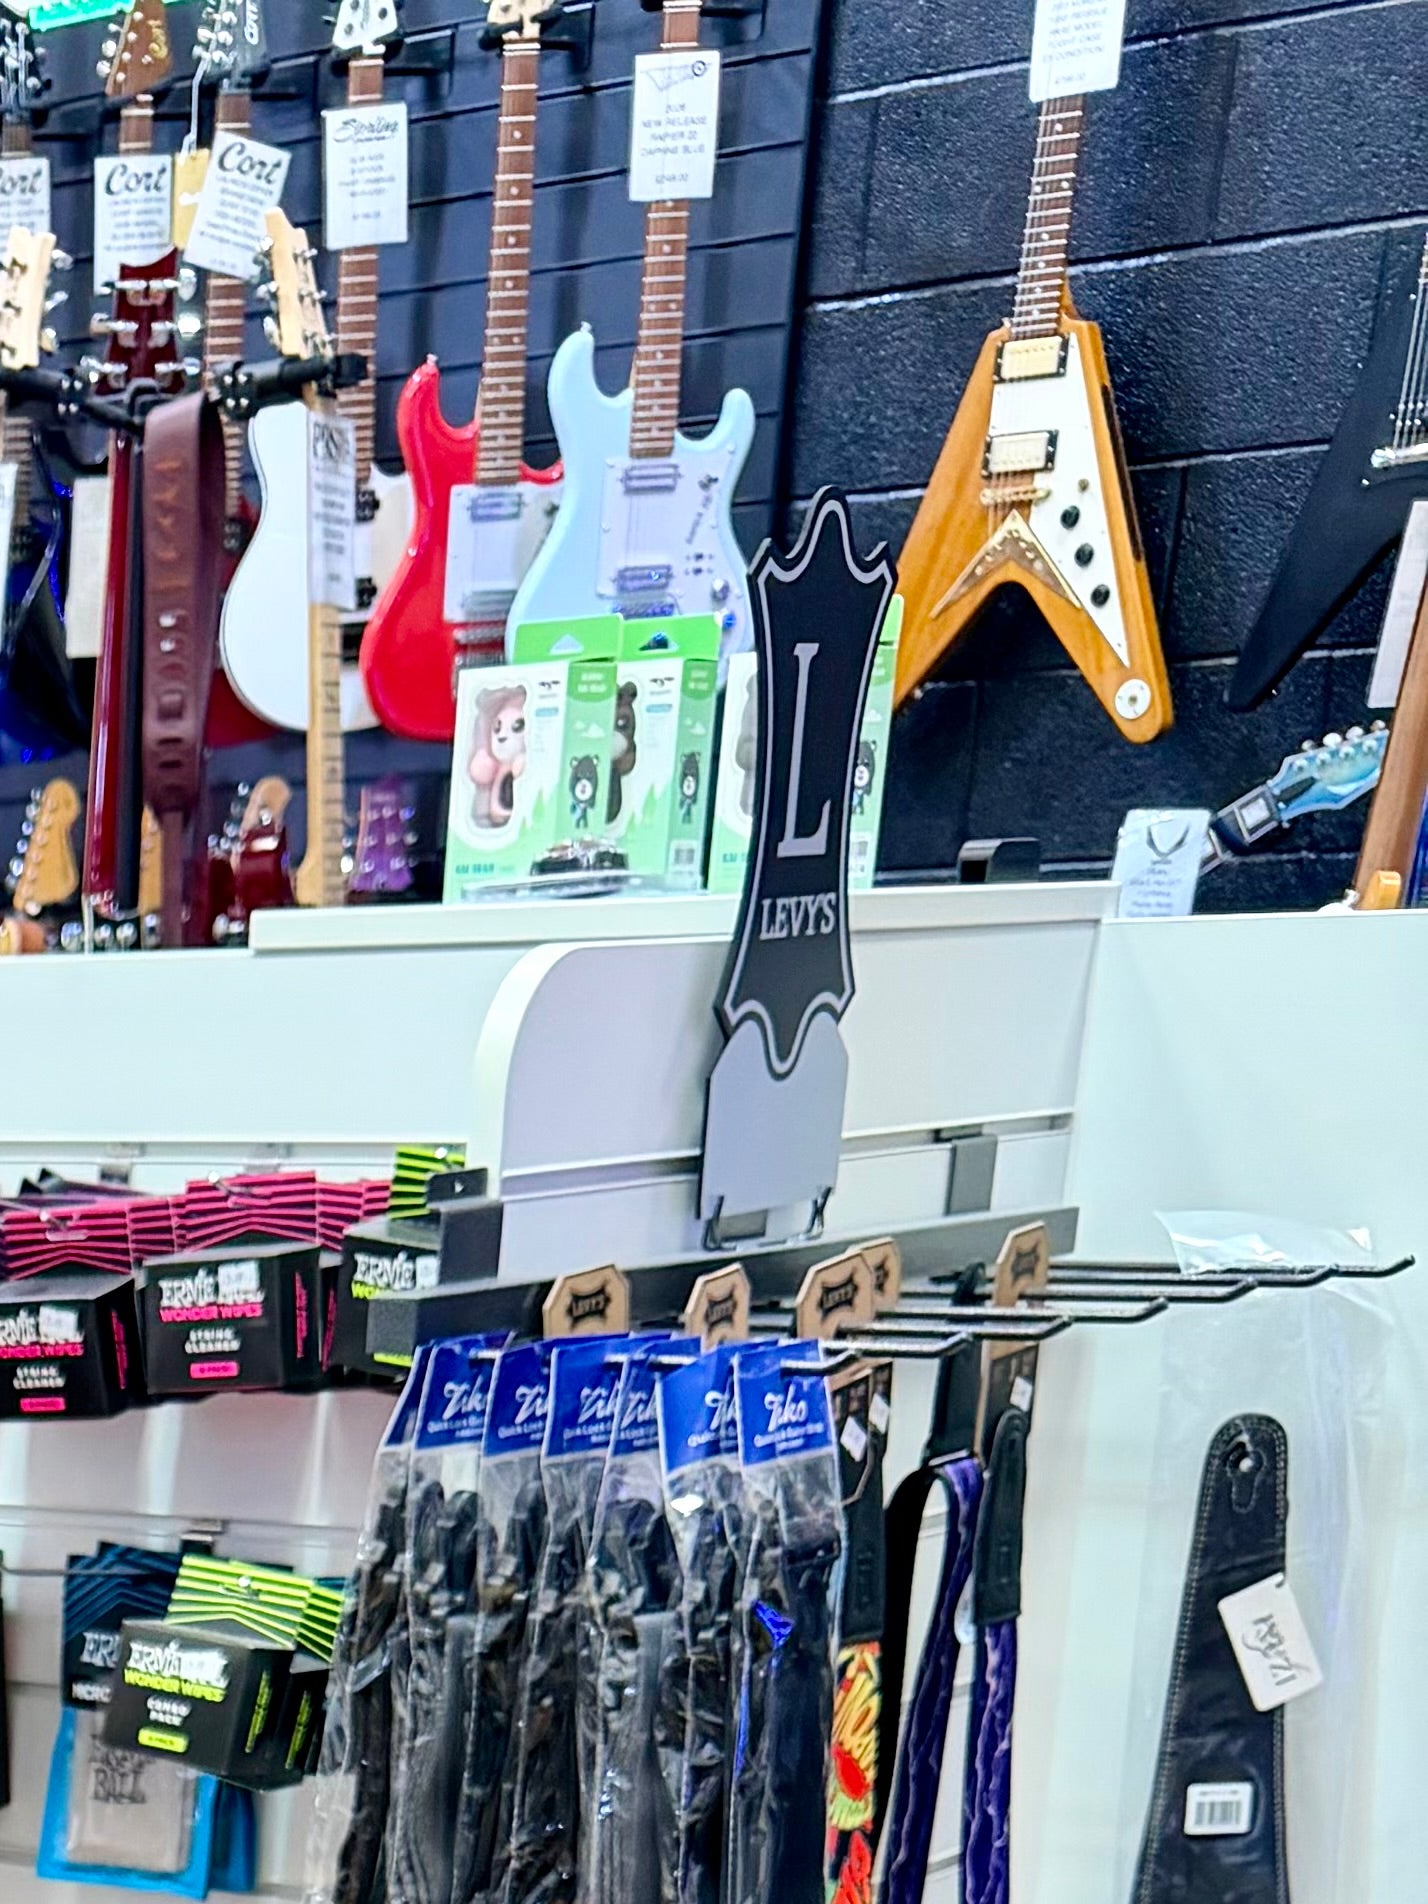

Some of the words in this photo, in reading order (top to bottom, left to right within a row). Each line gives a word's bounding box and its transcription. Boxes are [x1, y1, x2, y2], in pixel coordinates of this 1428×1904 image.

[105, 163, 168, 197] Cort
[218, 141, 284, 185] Cort
[777, 642, 831, 859] L
[760, 891, 837, 941] LEVY'S
[158, 1267, 217, 1308] ERNIE
[353, 1250, 416, 1291] ERNIE
[159, 1305, 220, 1323] WONDER
[221, 1302, 264, 1319] WIPES
[123, 1667, 181, 1693] WONDER
[181, 1680, 228, 1703] WIPES
